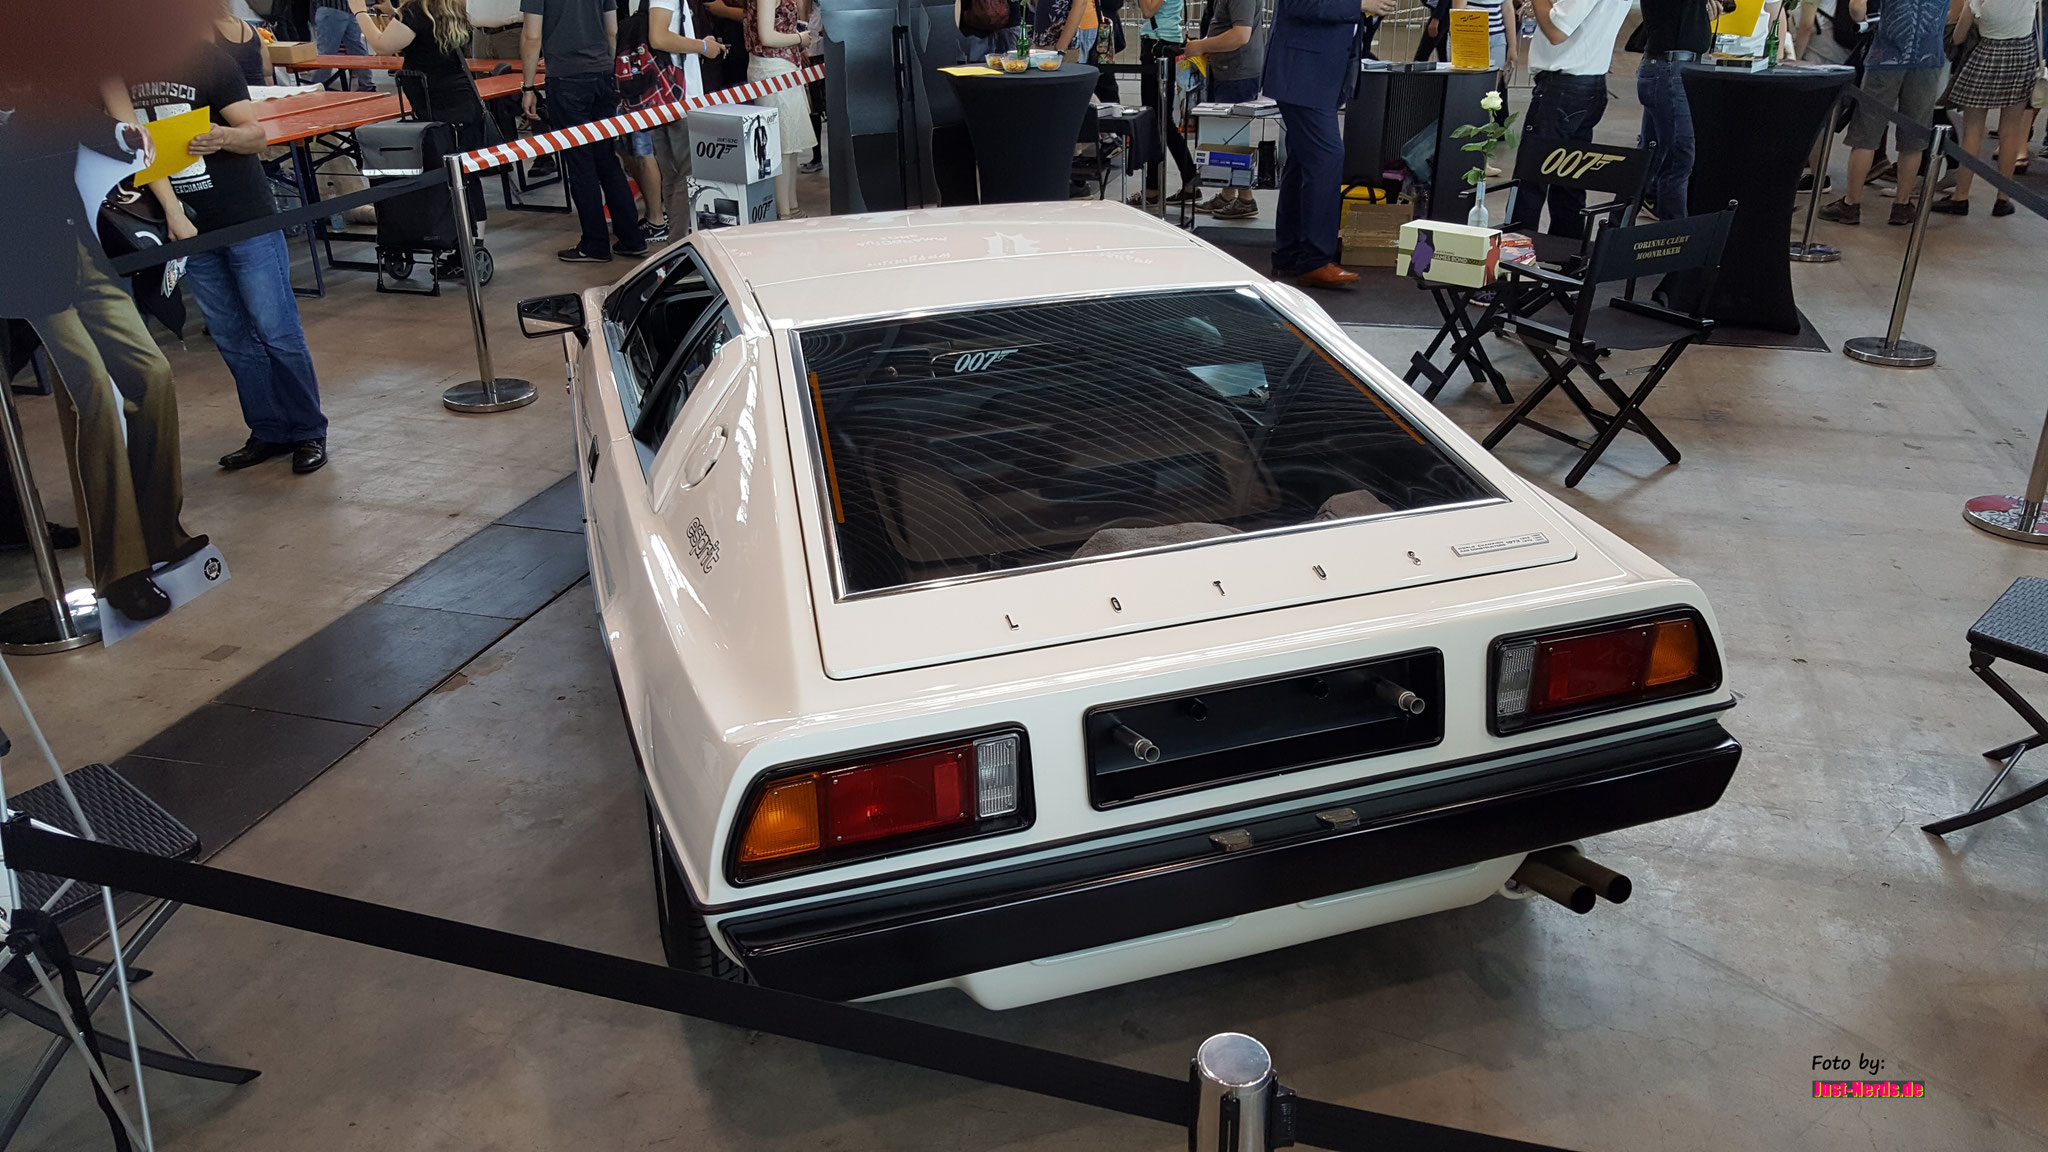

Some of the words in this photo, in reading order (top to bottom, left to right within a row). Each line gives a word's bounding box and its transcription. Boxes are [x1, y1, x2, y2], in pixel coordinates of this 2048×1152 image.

[131, 81, 196, 101] FRANCISCO
[696, 141, 738, 159] 007
[1541, 148, 1626, 179] 007
[174, 179, 214, 194] EXCHANGE
[752, 200, 774, 223] 007
[1633, 239, 1666, 250] CORINNE
[1636, 246, 1681, 260] MOONRAKER
[1451, 256, 1468, 264] BOND
[954, 348, 1019, 373] 007
[686, 516, 720, 574] esprit
[1005, 550, 1422, 631] LOTUS
